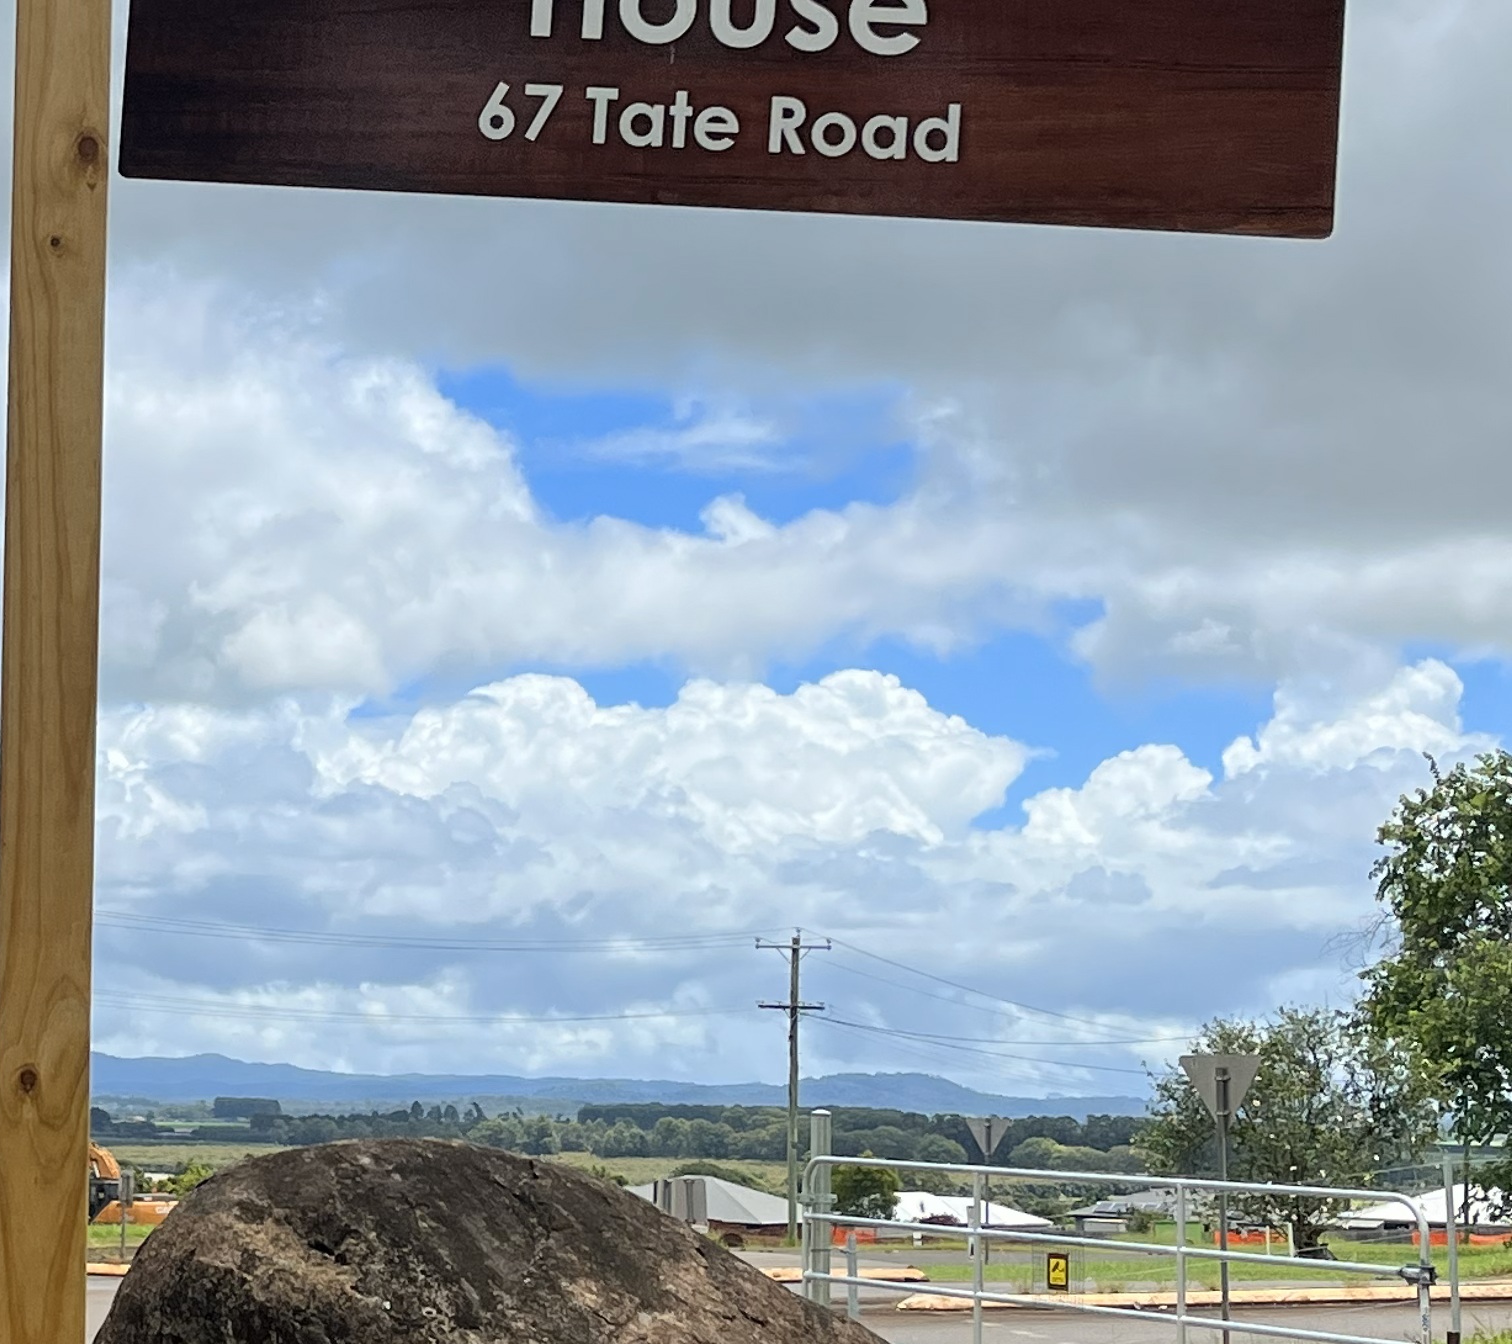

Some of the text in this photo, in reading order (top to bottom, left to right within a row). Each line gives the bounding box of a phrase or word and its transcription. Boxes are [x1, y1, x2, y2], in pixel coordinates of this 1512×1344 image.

[477, 81, 962, 163] 67 Tate Road
